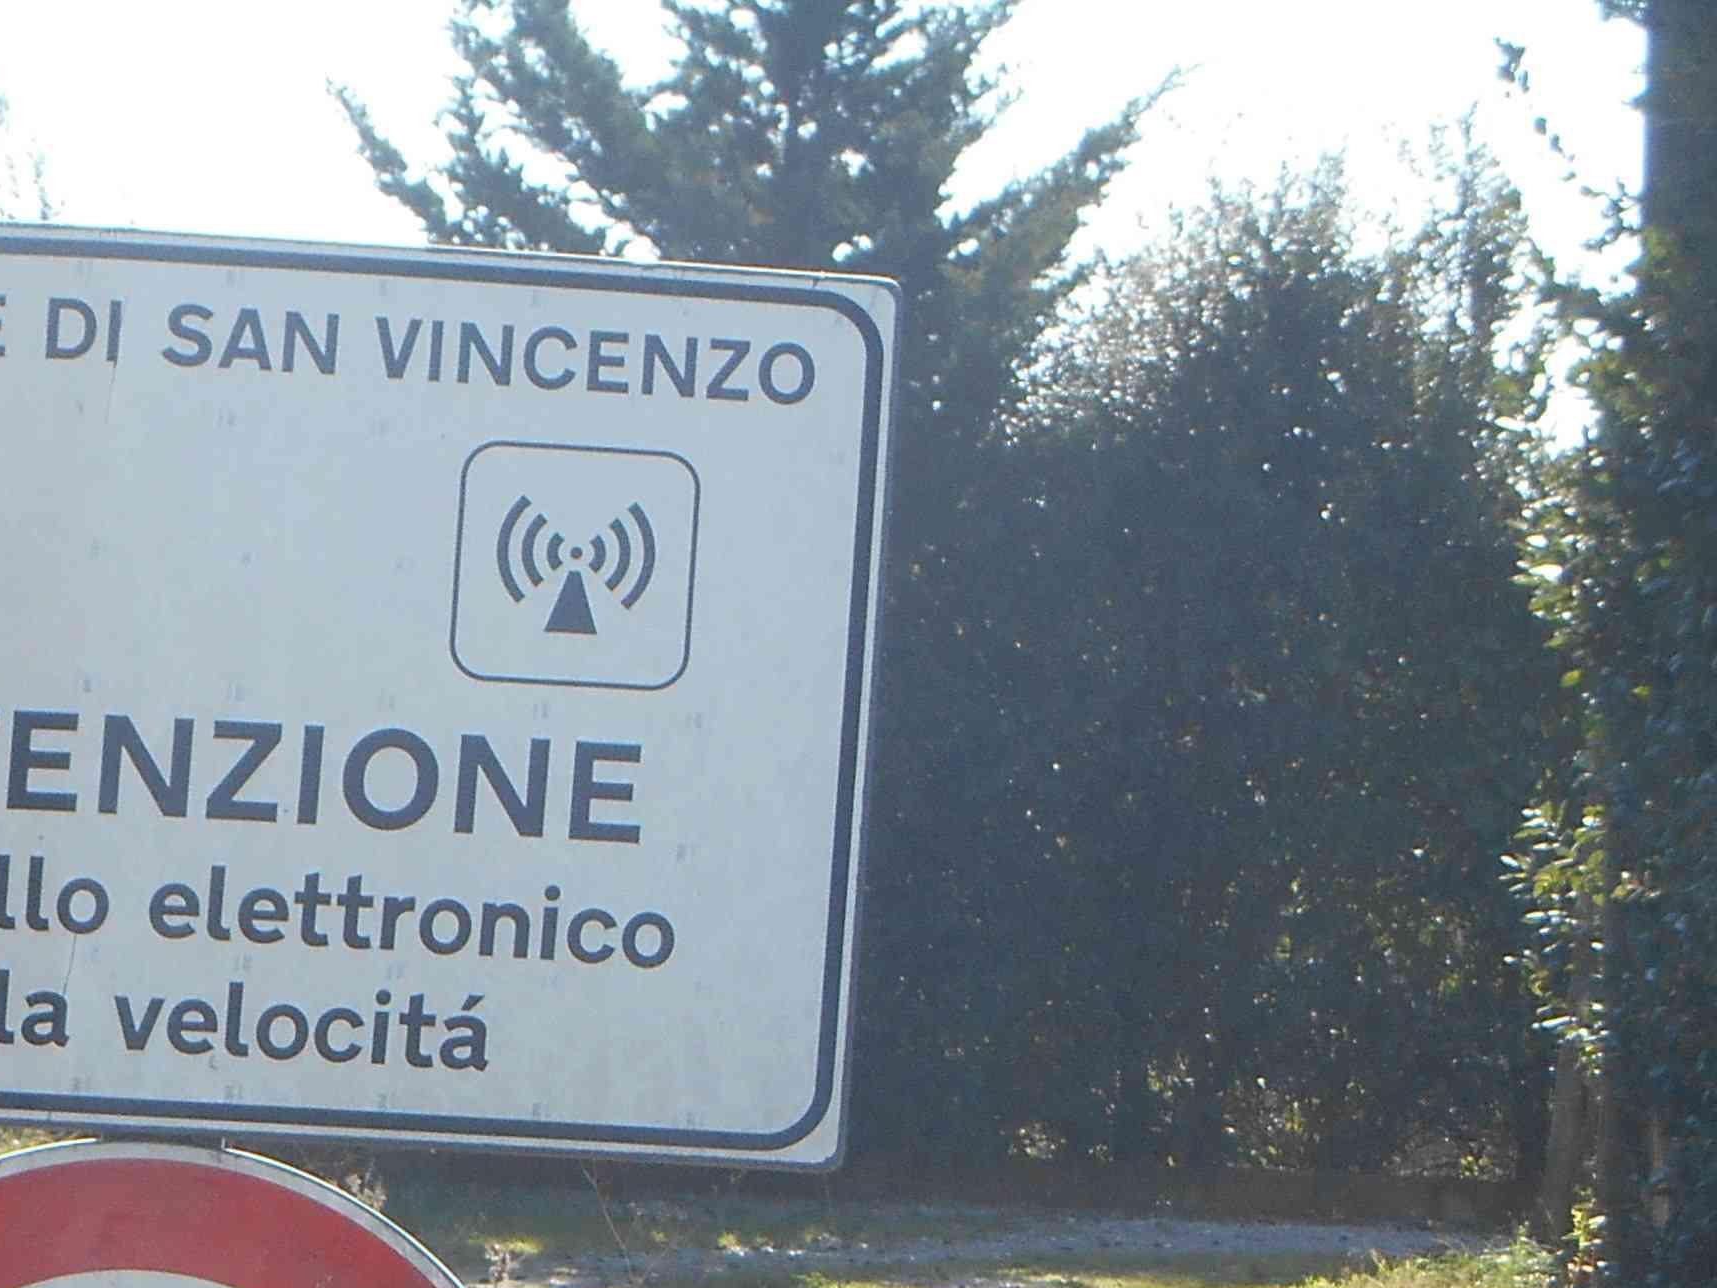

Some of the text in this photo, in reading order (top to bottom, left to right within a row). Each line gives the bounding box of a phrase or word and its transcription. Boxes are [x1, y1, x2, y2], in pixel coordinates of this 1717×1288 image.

[44, 297, 122, 364] DI
[161, 303, 340, 376] SAN
[375, 316, 816, 406] VINCENZO
[148, 865, 675, 969] elettronico
[114, 981, 489, 1072] velocitá
